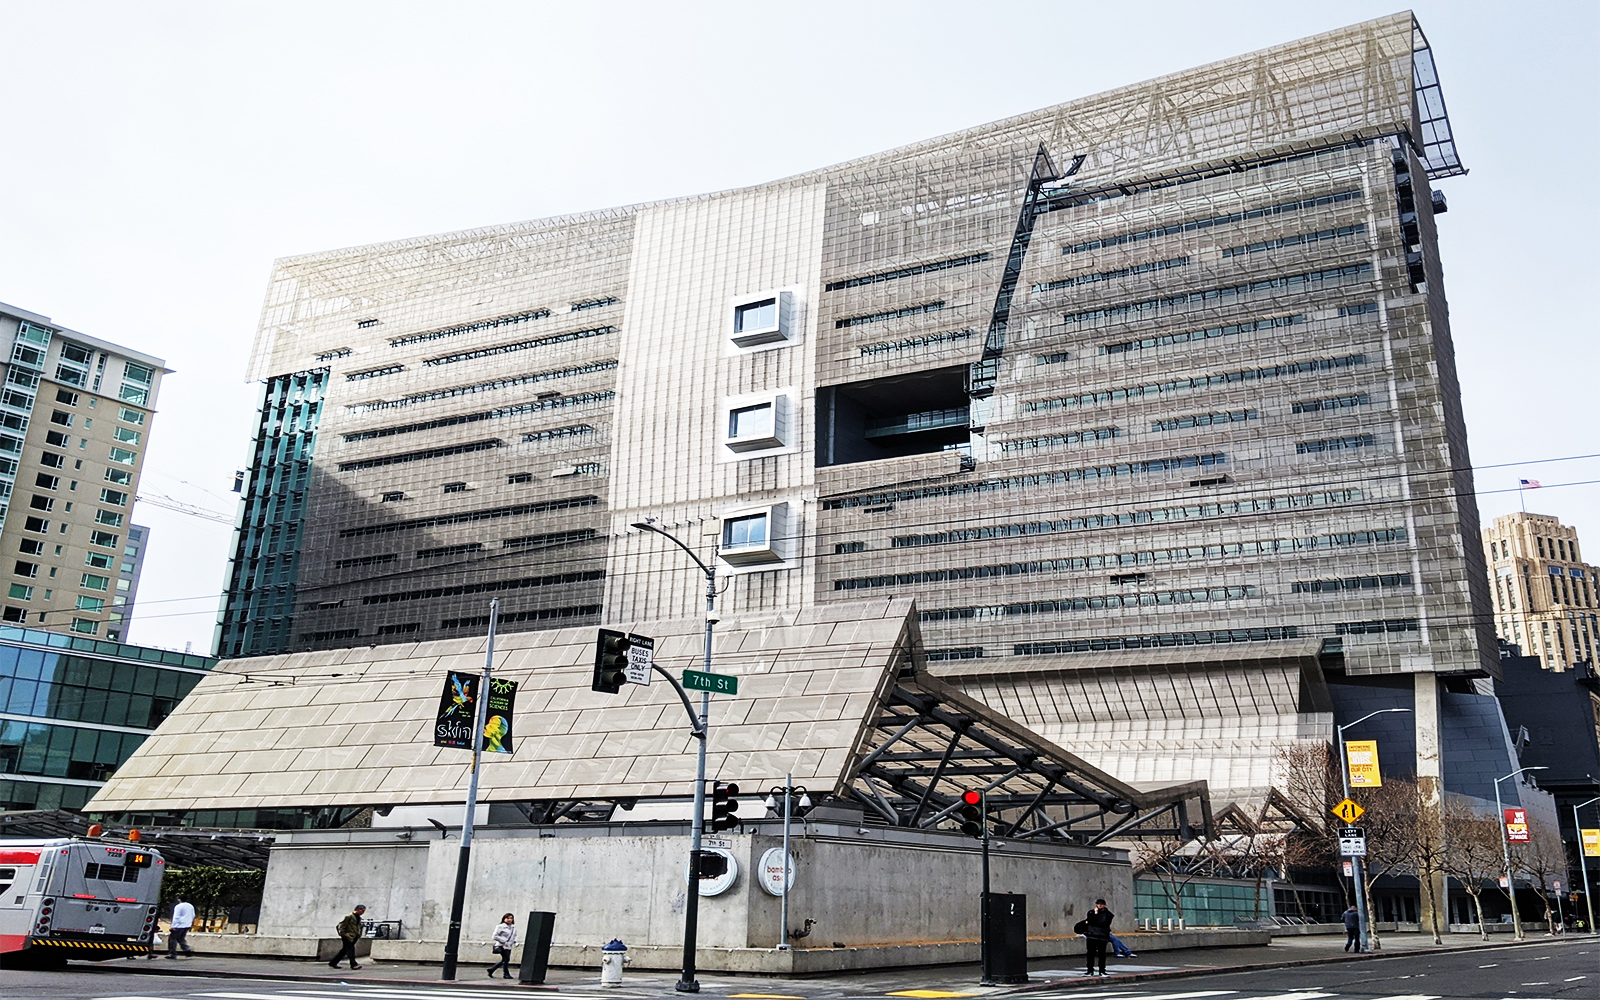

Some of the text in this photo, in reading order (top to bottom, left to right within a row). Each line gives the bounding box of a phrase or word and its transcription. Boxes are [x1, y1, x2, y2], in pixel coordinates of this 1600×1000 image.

[630, 636, 642, 644] RIGHT
[631, 648, 648, 658] BUSES
[632, 656, 647, 664] TAXIS
[631, 662, 646, 672] ONLY
[692, 676, 729, 690] 7th St
[134, 854, 144, 862] 14
